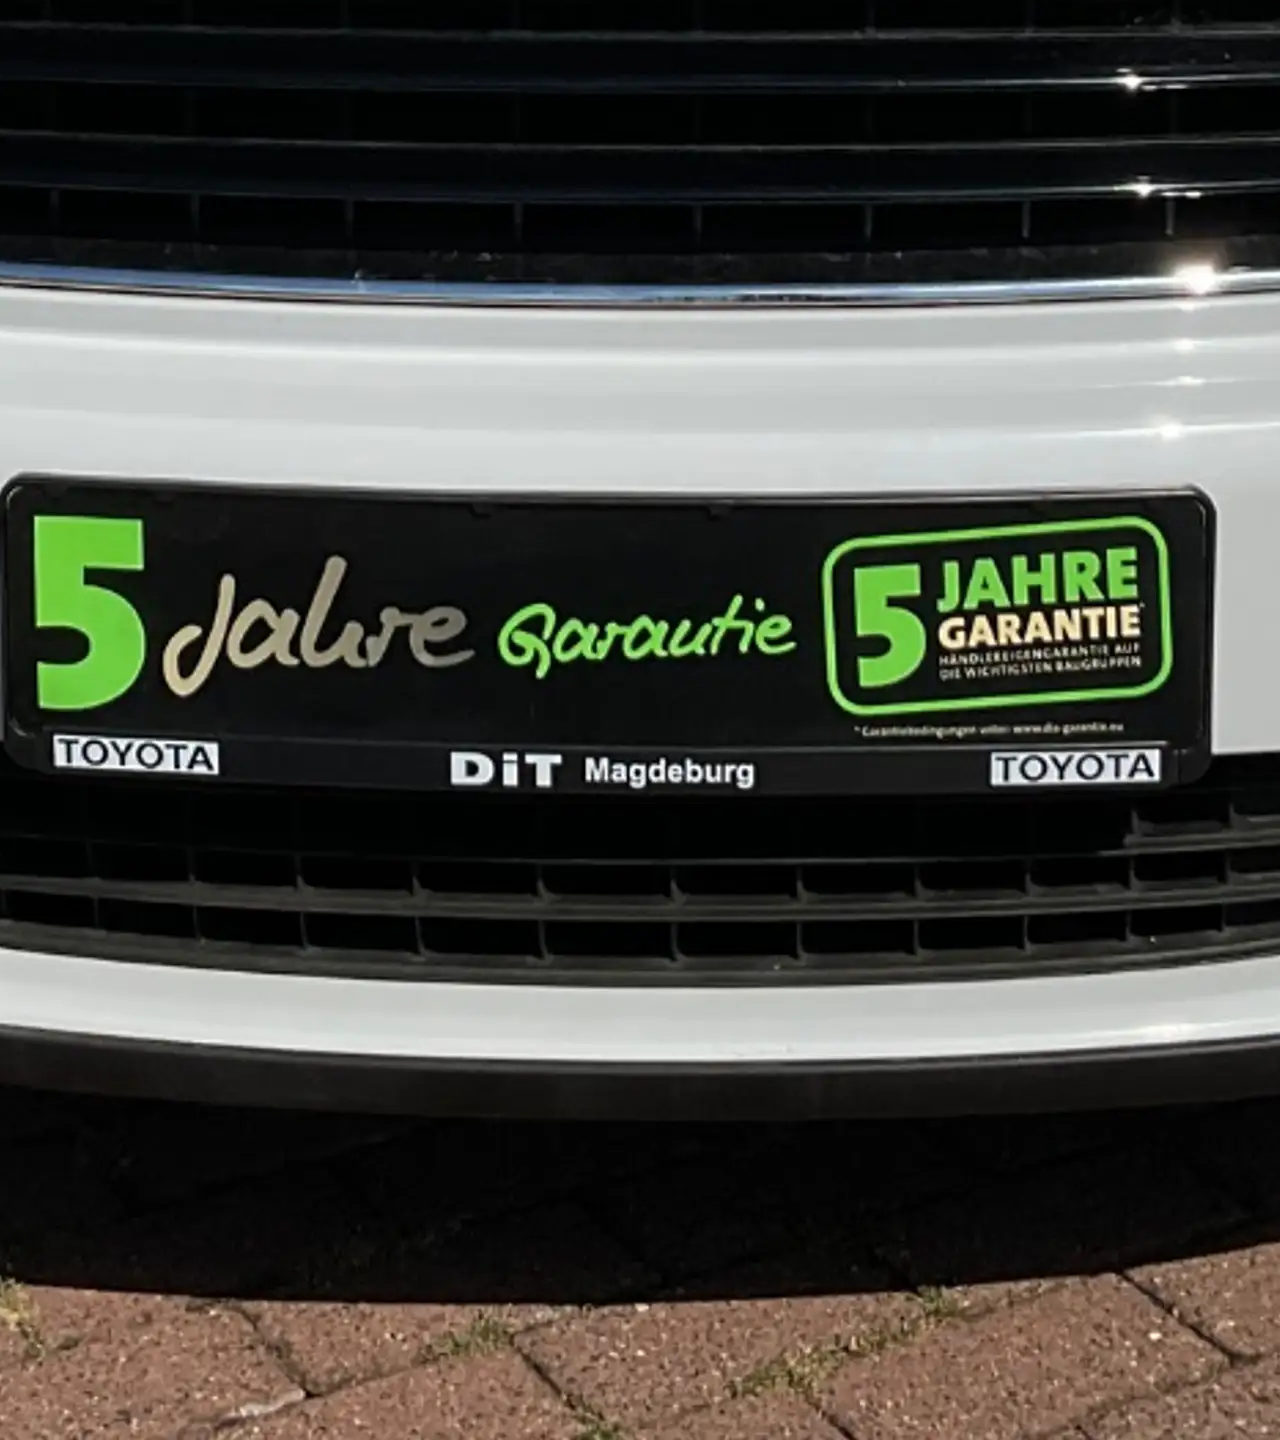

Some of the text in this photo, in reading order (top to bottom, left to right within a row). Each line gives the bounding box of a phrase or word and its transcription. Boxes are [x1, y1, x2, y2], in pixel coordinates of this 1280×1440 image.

[936, 546, 1140, 614] JAHRE
[33, 515, 798, 711] 5 Jahre Garantie
[853, 563, 927, 688] 5
[1114, 640, 1141, 655] AUF
[938, 666, 962, 681] DIE
[965, 660, 1053, 679] WICHTIGSTEN
[58, 738, 215, 772] TOYOTA
[450, 751, 755, 789] DiT Magdeburg
[996, 752, 1156, 783] TOYOTA
